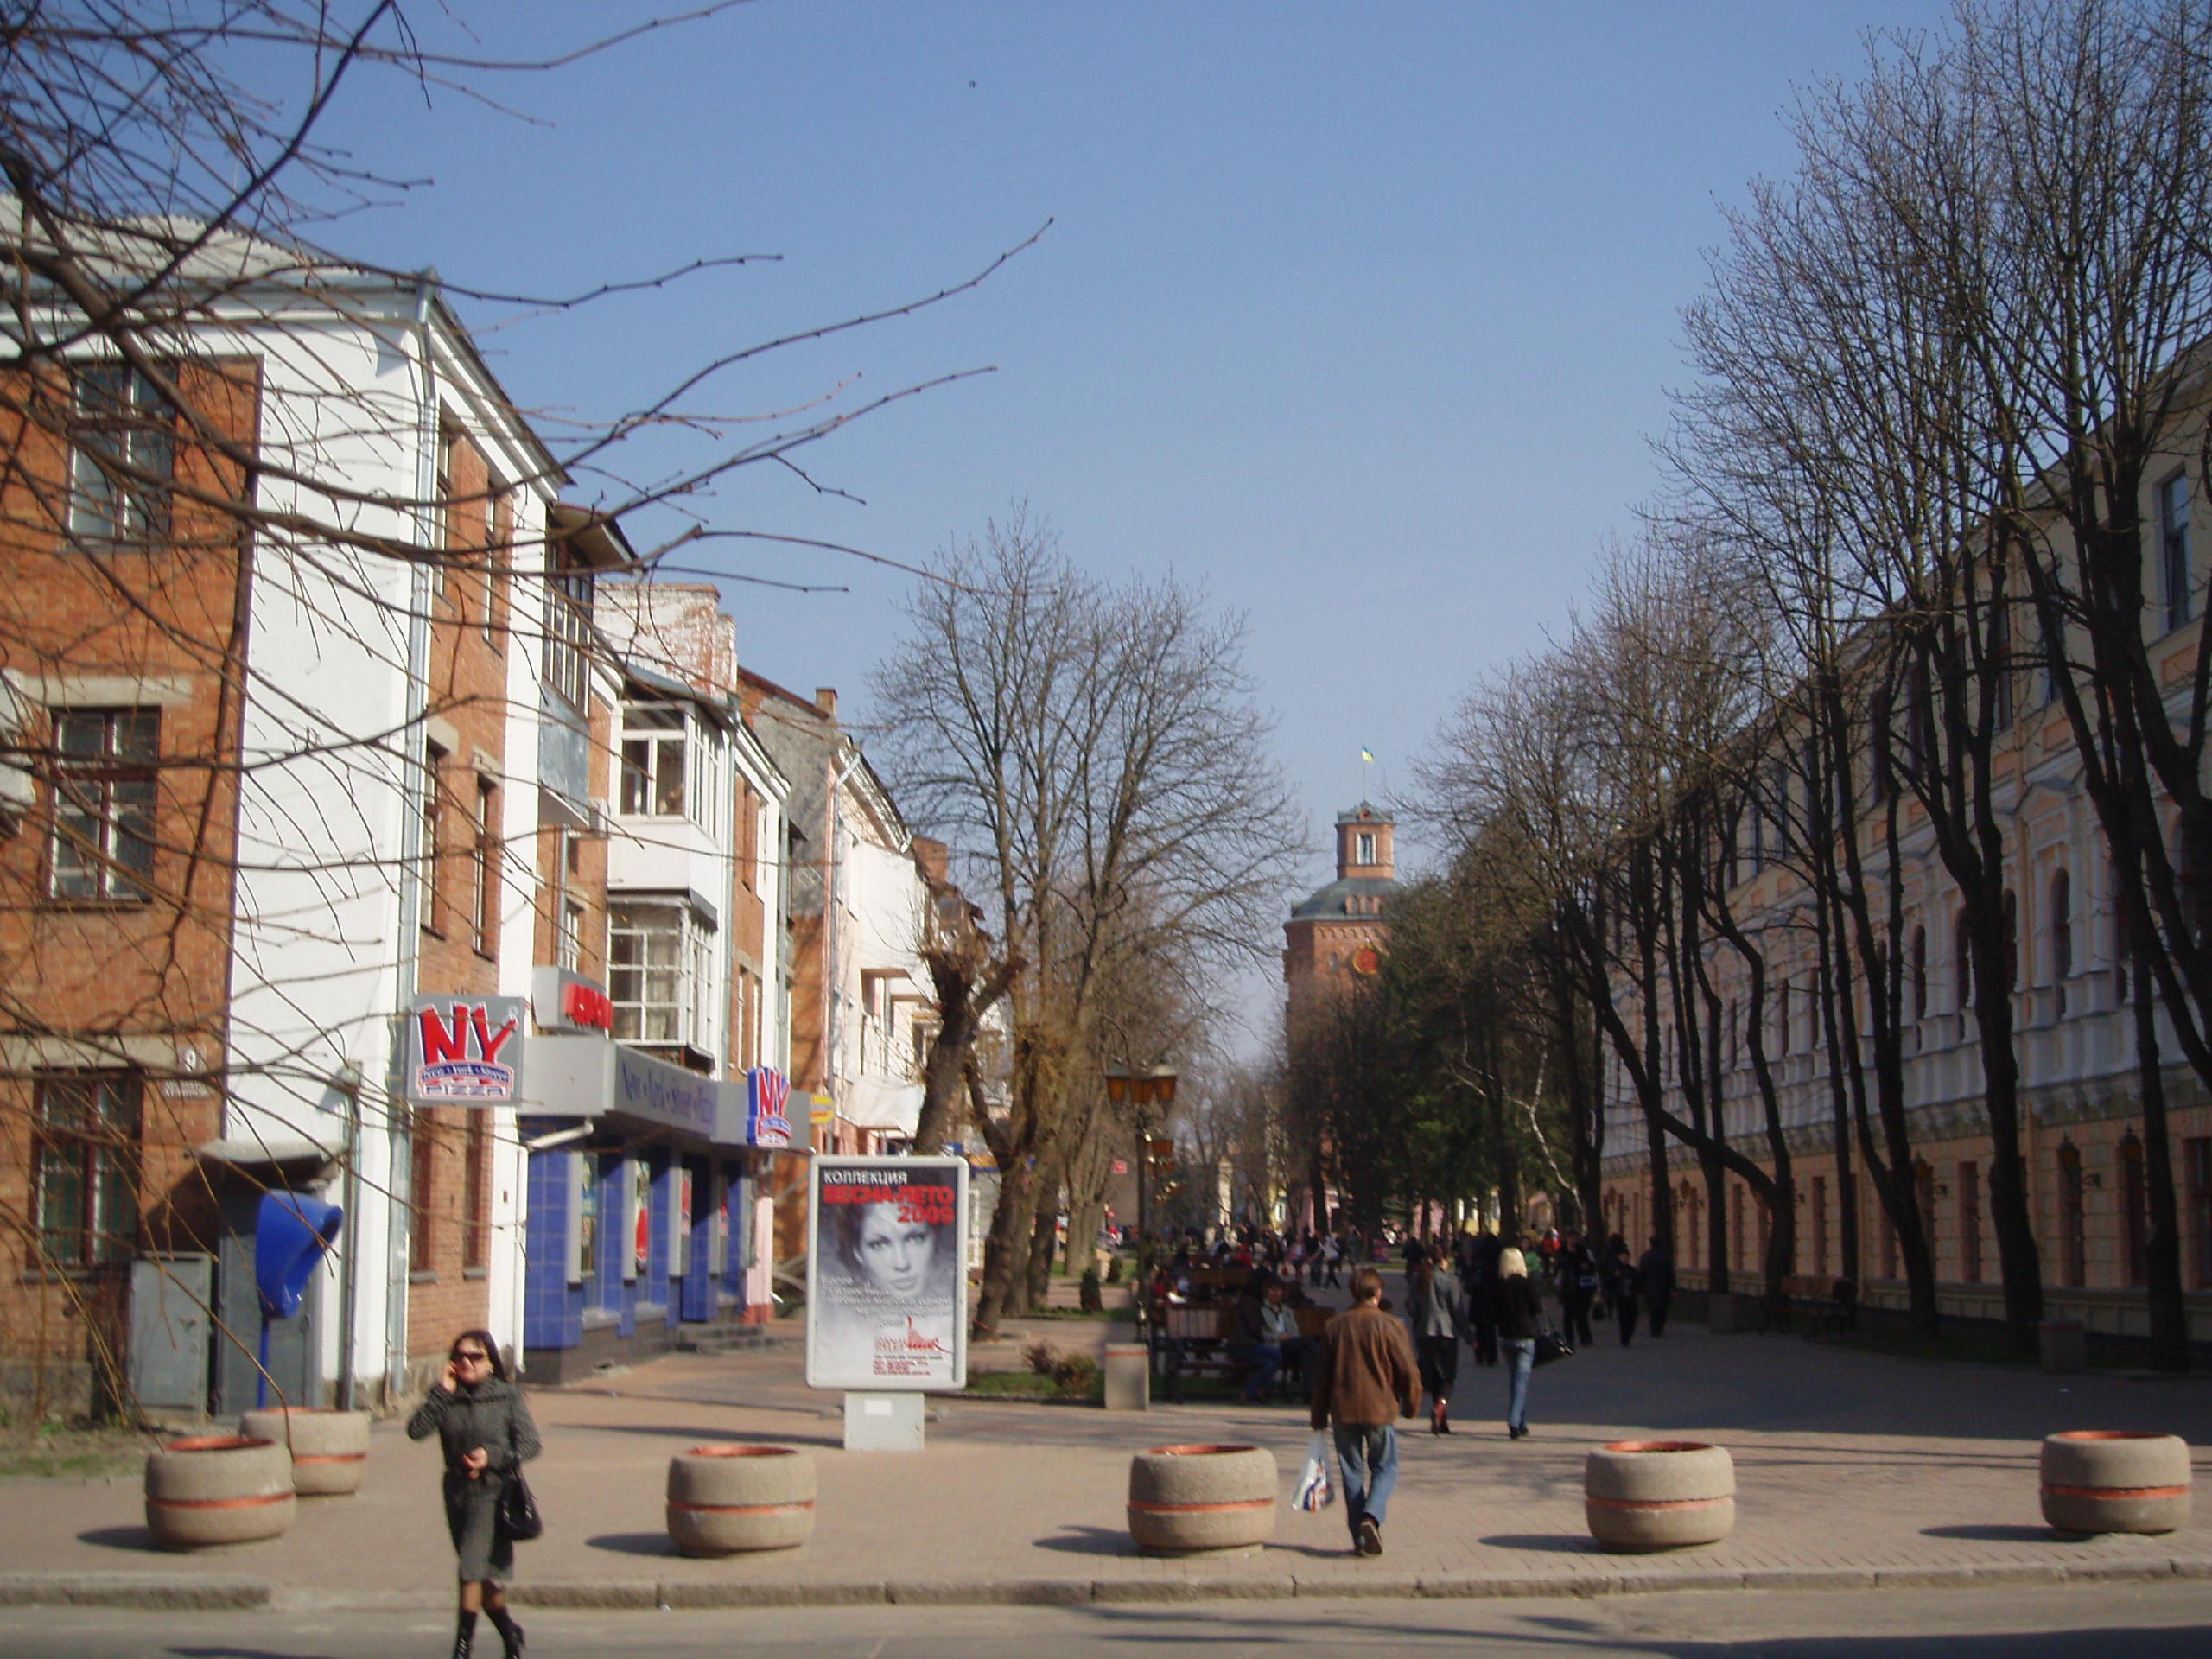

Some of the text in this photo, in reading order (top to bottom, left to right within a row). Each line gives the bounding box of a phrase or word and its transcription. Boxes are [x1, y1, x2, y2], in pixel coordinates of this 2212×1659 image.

[418, 1002, 518, 1065] NY
[759, 1068, 791, 1118] NY
[823, 1170, 907, 1185] КОЛЛЕКЦИЯ
[898, 1205, 955, 1224] 2009
